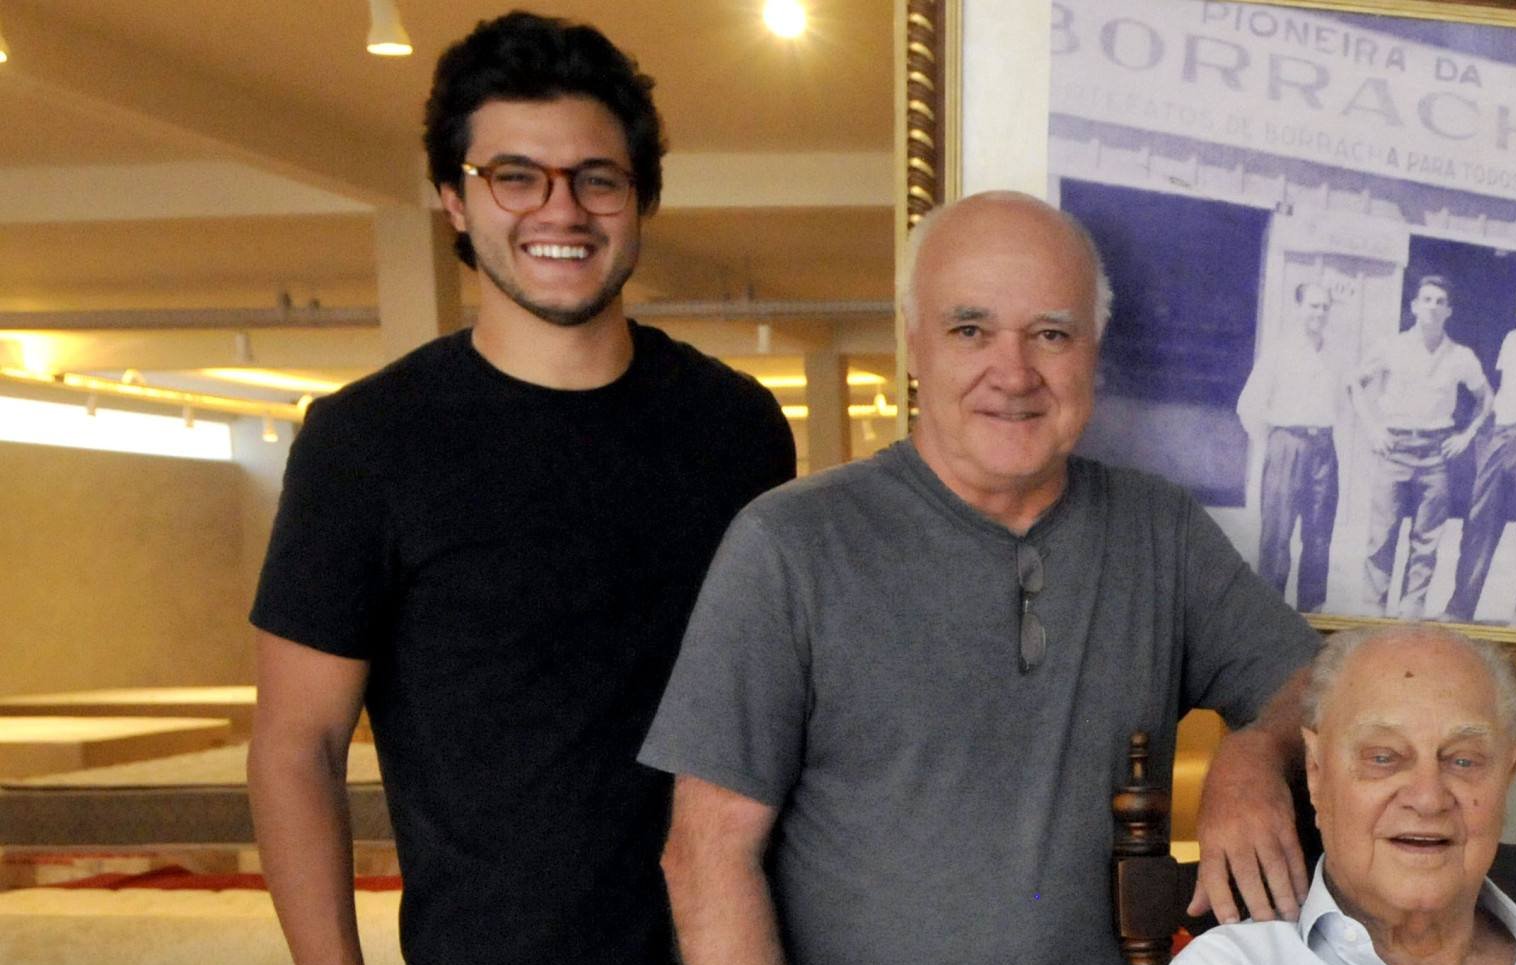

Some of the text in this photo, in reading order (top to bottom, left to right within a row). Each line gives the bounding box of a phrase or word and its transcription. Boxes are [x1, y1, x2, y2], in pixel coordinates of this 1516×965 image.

[1202, 1, 1484, 88] PIONEIRA DA
[1406, 151, 1456, 180] PARA
